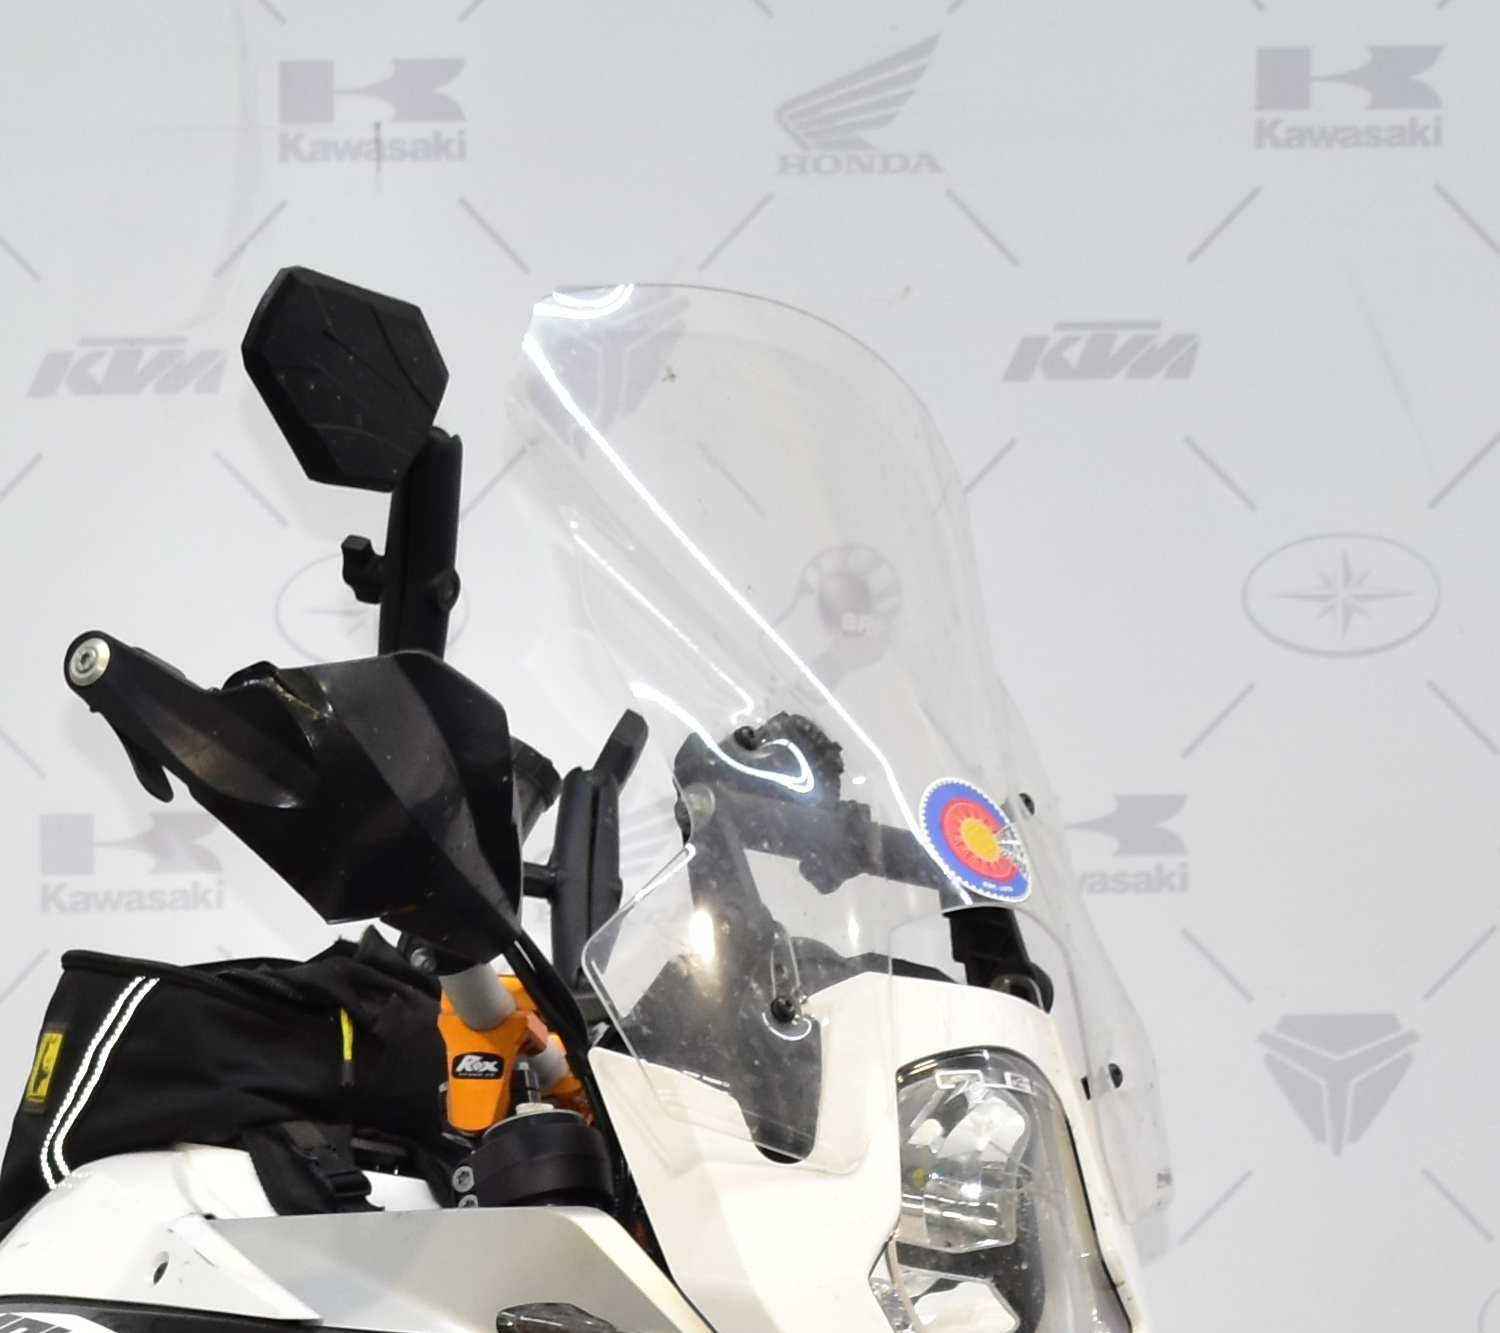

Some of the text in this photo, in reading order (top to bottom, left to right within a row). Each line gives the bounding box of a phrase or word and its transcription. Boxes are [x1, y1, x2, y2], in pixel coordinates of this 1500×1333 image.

[279, 130, 467, 163] Kawasaki
[1255, 116, 1443, 149] Kawasaki
[778, 153, 943, 175] HONDA
[27, 336, 226, 397] KTM
[1004, 321, 1199, 381] KTM
[1080, 863, 1189, 893] asaki
[39, 880, 224, 912] Kawasaki
